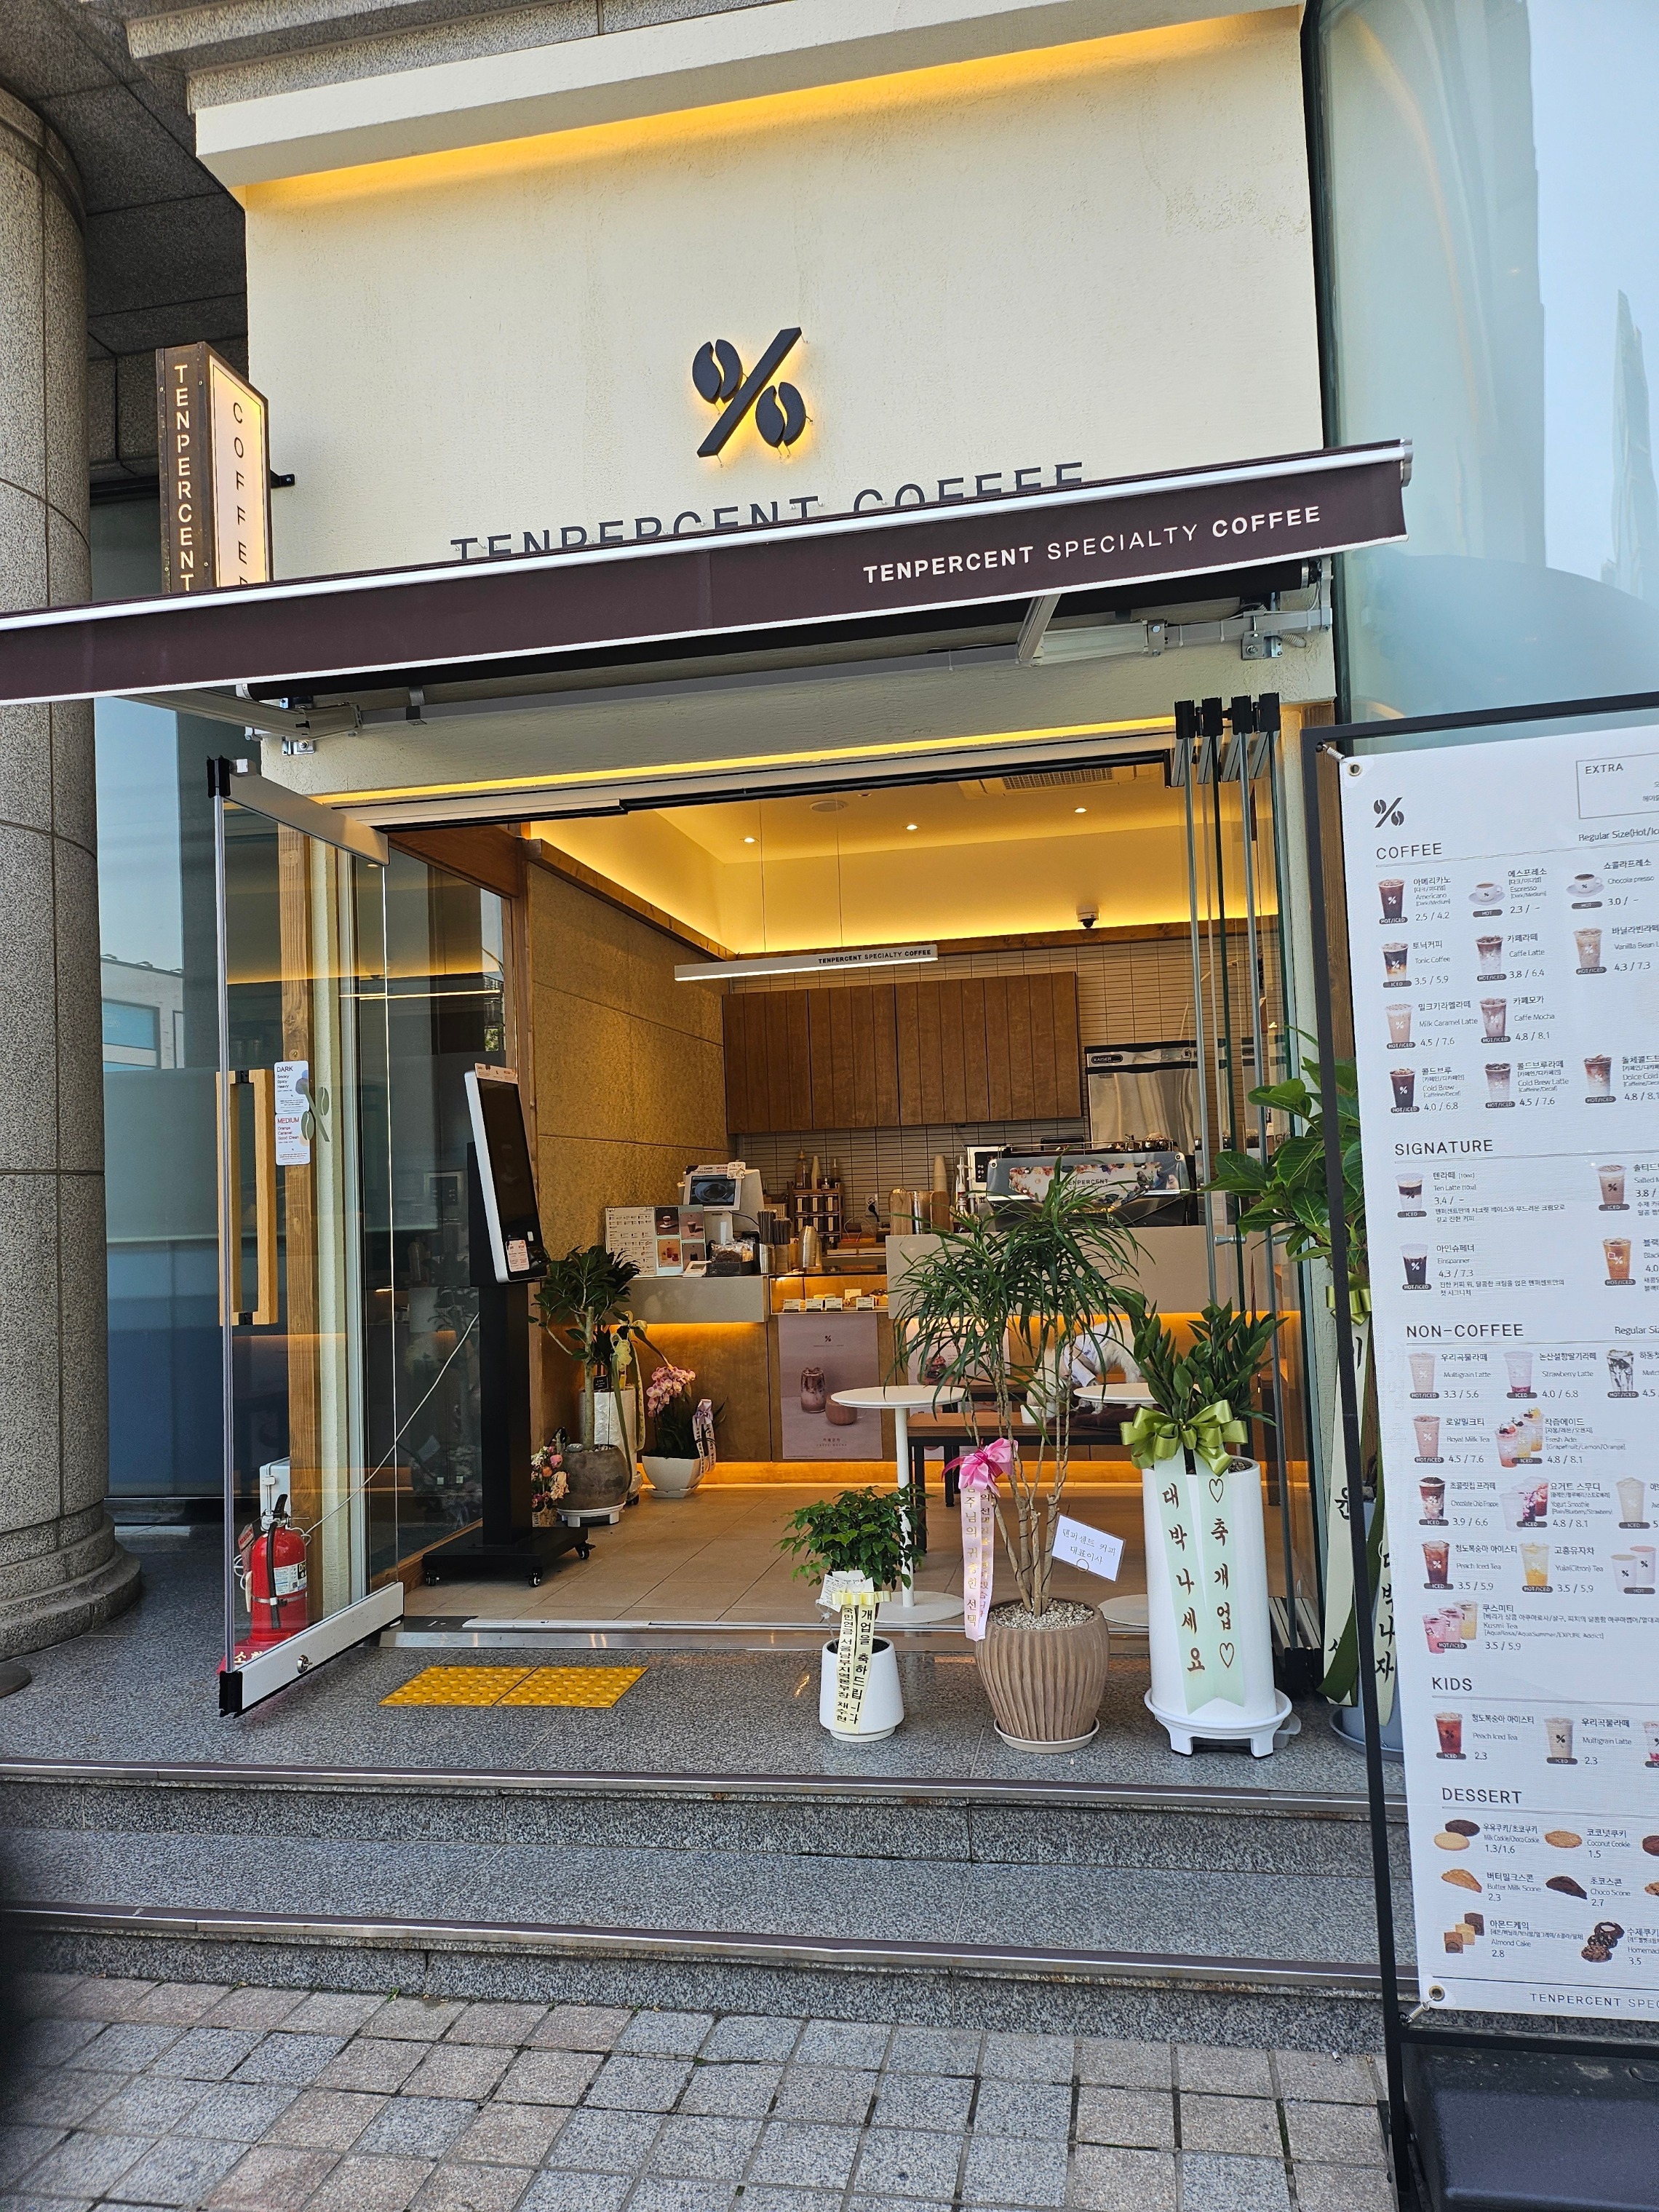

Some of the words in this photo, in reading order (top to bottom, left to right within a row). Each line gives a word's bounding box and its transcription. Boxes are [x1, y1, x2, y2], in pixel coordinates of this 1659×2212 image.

[173, 364, 194, 591] TENPERCENT
[233, 402, 247, 584] COFFE
[864, 546, 1033, 583] TENPERCENT
[1047, 524, 1198, 560] SPECIALTY
[1212, 506, 1321, 538] COFFEE
[1585, 763, 1623, 774] EXTRA
[1578, 832, 1609, 842] Regular
[1376, 842, 1442, 860] COFFEE
[1603, 859, 1652, 870] 쇼콜라프레소
[1508, 867, 1547, 878] 에스프레소
[1412, 876, 1451, 885] 아메리카노
[1607, 897, 1621, 906] 3.0
[1509, 905, 1523, 914] 2.3
[1415, 912, 1428, 921] 2.5
[1437, 911, 1449, 919] 4.2
[1507, 932, 1537, 942] 카페라떼
[1412, 939, 1442, 950] 토닉커피
[818, 955, 862, 963] TENPERCENT
[864, 951, 902, 959] SPECIALTY
[1614, 963, 1628, 971] 4.3
[1637, 961, 1650, 969] 7.3
[1508, 970, 1522, 979] 3.8
[1532, 968, 1544, 977] 6.4
[1414, 977, 1426, 985] 3.5
[1436, 975, 1448, 983] 5.9
[1513, 995, 1544, 1005] 카페모카
[1513, 1014, 1532, 1022] Caffe
[1515, 1033, 1528, 1041] 4.8
[1537, 1031, 1550, 1040] 8.1
[1420, 1038, 1432, 1046] 4.5
[1441, 1037, 1455, 1045] 7.6
[1516, 1059, 1564, 1070] 콜드브루라떼
[1421, 1066, 1452, 1075] 콜드브루
[1624, 1092, 1637, 1100] 4.8
[1519, 1098, 1532, 1106] 4.5
[1541, 1097, 1555, 1105] 7.6
[1423, 1103, 1436, 1111] 4.0
[1446, 1102, 1458, 1110] 6.8
[1394, 1139, 1493, 1156] SIGNATURE
[1433, 1171, 1455, 1180] 텐라떼
[1636, 1189, 1649, 1197] 3.8
[1434, 1196, 1447, 1204] 3.4
[1436, 1244, 1474, 1252] 아인슈페너
[1439, 1269, 1451, 1278] 4.3
[1460, 1269, 1473, 1277] 7.3
[1406, 1324, 1524, 1338] NON-COFFEE
[1614, 1325, 1646, 1336] Regular
[1441, 1353, 1487, 1361] 우리곡물라떼
[1443, 1390, 1456, 1398] 3.3
[1466, 1390, 1479, 1398] 5.6
[1542, 1390, 1555, 1398] 4.0
[1544, 1417, 1584, 1426] 착즙에이드
[1448, 1455, 1460, 1463] 4.5
[1471, 1455, 1484, 1463] 7.6
[1547, 1455, 1560, 1463] 4.8
[1570, 1455, 1583, 1463] 8.1
[1550, 1482, 1574, 1490] 요거트
[1576, 1482, 1601, 1490] 스무디
[1452, 1517, 1465, 1525] 3.9
[1475, 1517, 1488, 1526] 6.6
[1552, 1519, 1566, 1527] 4.8
[1575, 1519, 1588, 1527] 8.1
[1099, 1543, 1115, 1556] 커피
[1490, 1545, 1517, 1553] 아이스티
[1553, 1546, 1594, 1555] 고흥유자차
[1070, 1545, 1102, 1564] 대표이사
[1481, 1582, 1493, 1590] 5.9
[1556, 1584, 1570, 1592] 3.5
[1580, 1584, 1594, 1592] 5.9
[966, 1599, 976, 1626] 선택
[1482, 1604, 1513, 1612] 쿠스미티
[842, 1607, 854, 1634] 국민연금
[859, 1609, 872, 1644] 개업을
[1484, 1641, 1498, 1650] 3.5
[1508, 1642, 1521, 1650] 5.9
[848, 1652, 869, 1724] 축하드립니다
[1431, 1676, 1472, 1691] KIDS
[1507, 1715, 1534, 1724] 아이스티
[1581, 1718, 1629, 1727] 우리곡물라떼
[1474, 1751, 1487, 1760] 2.3
[1584, 1757, 1598, 1765] 2.3
[1441, 1787, 1521, 1804] DESSERT
[1586, 1828, 1626, 1838] 코코넛쿠키
[1485, 1844, 1515, 1853] 1.3/1.6
[1588, 1850, 1601, 1858] 1.5
[1486, 1871, 1534, 1882] 버터밀크스콘
[1590, 1877, 1622, 1885] 초코스콘
[1507, 1883, 1520, 1891] Milk
[1487, 1893, 1501, 1901] 2.3
[1591, 1898, 1604, 1906] 2.7
[1489, 1919, 1529, 1930] 아몬드케익
[1491, 1938, 1514, 1946] Almond
[1491, 1949, 1505, 1957] 2.8
[1628, 1957, 1642, 1965] 3.5
[1529, 1992, 1621, 2006] TENPERCENT
